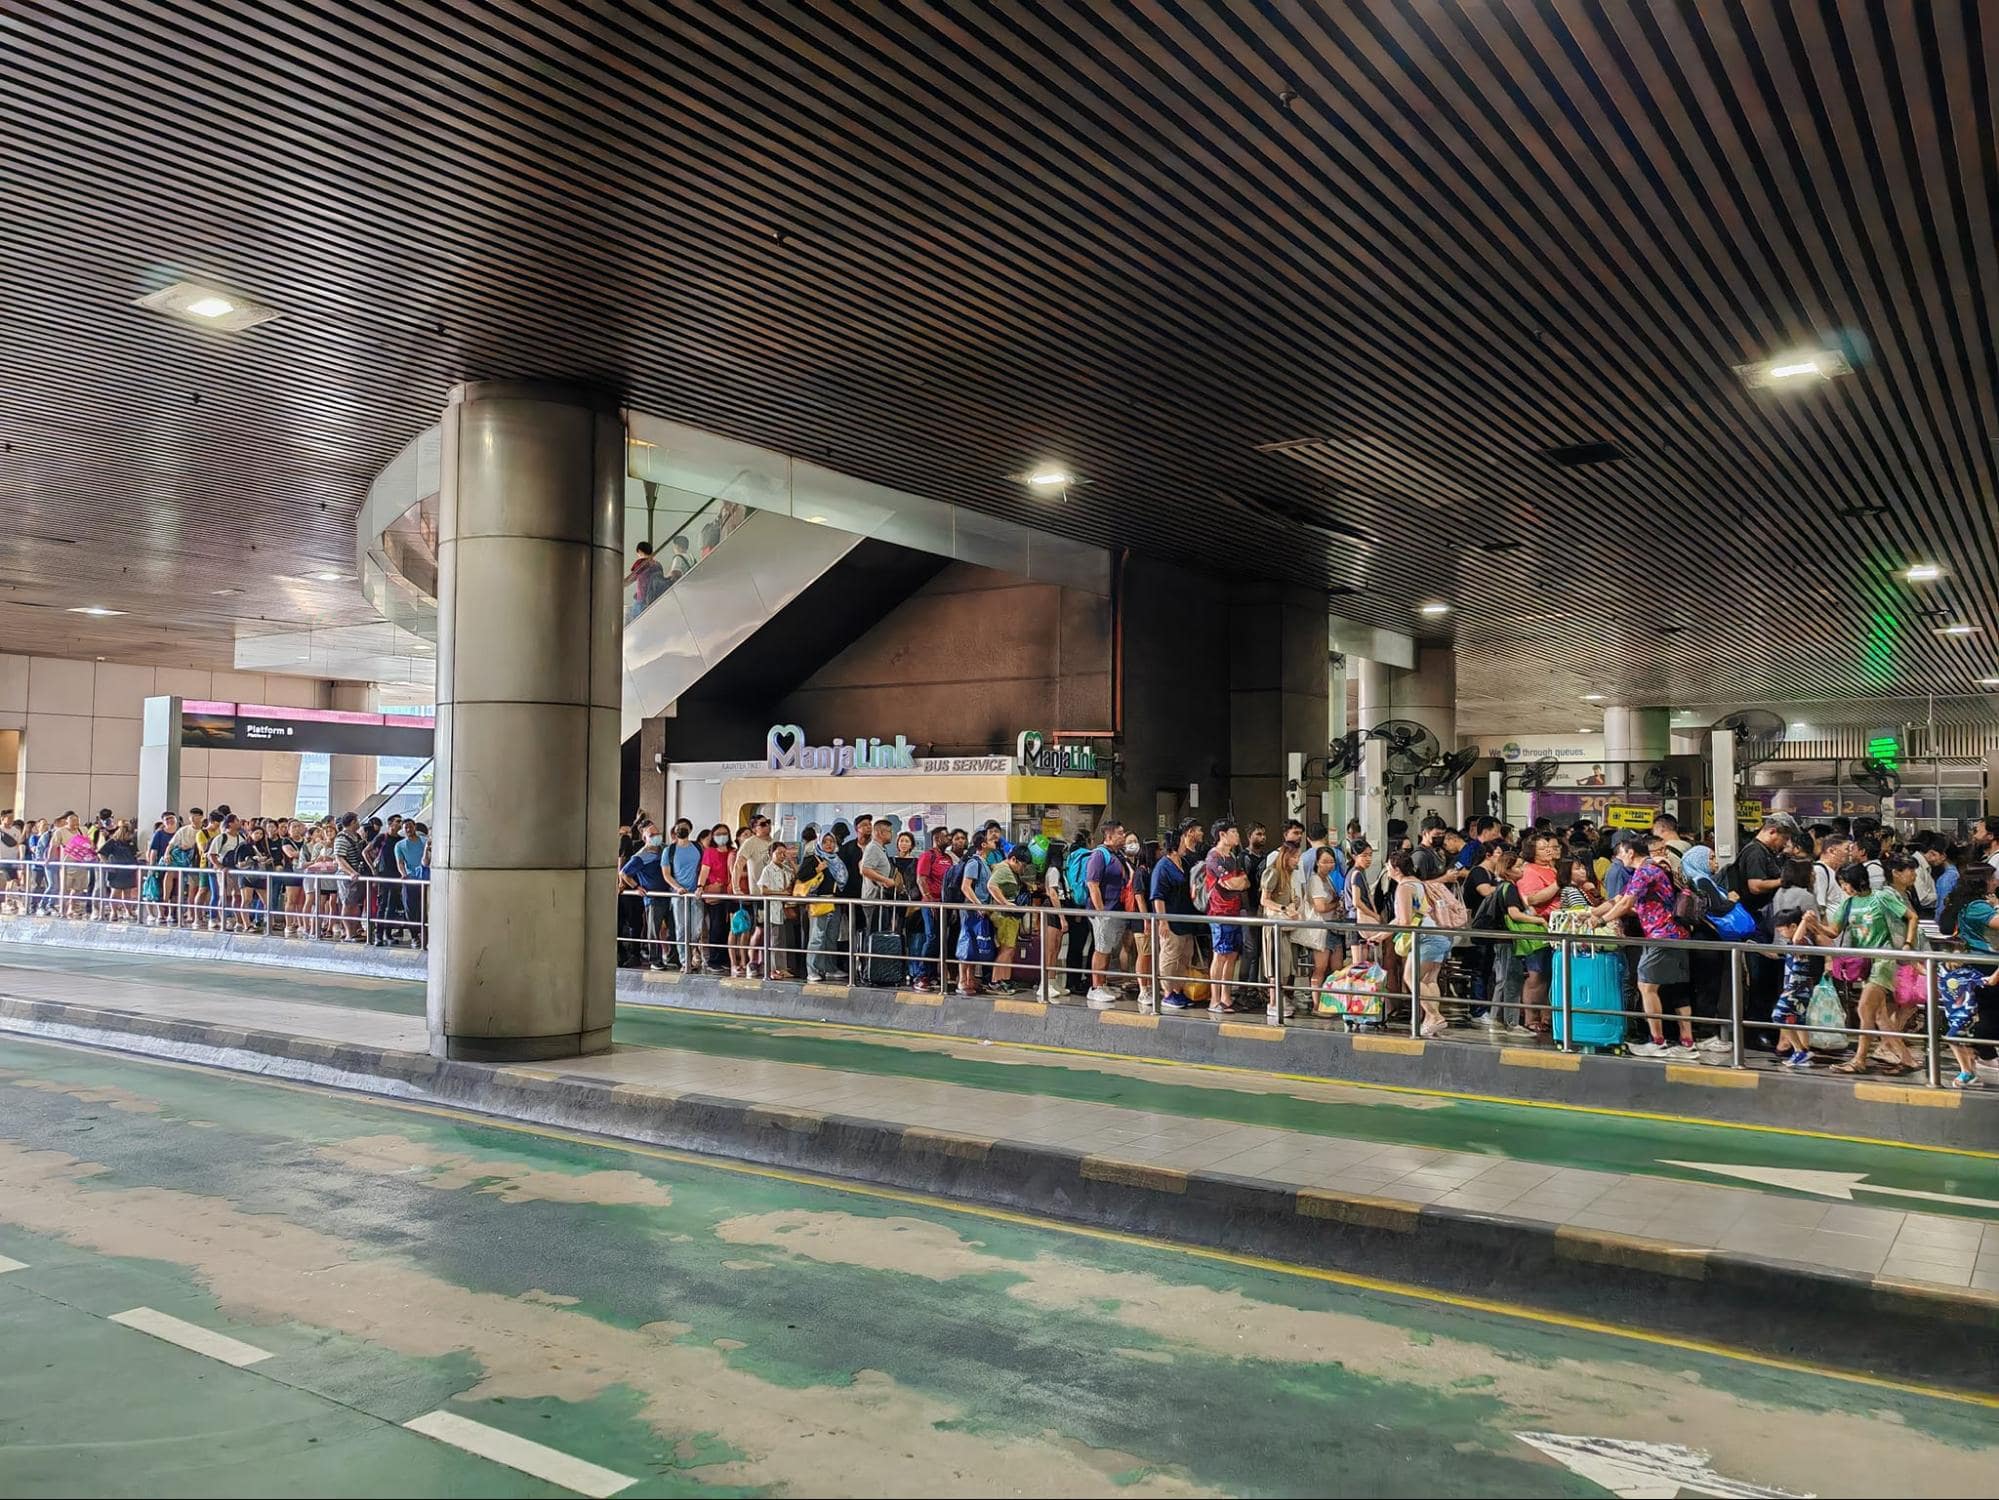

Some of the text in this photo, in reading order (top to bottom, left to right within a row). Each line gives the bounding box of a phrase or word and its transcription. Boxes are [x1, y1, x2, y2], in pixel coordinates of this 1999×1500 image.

[247, 724, 285, 735] Platform
[767, 724, 916, 776] ManjaLink
[1020, 731, 1097, 775] ManjaLink
[1522, 748, 1553, 757] through
[923, 758, 1007, 772] BUS SERVICE
